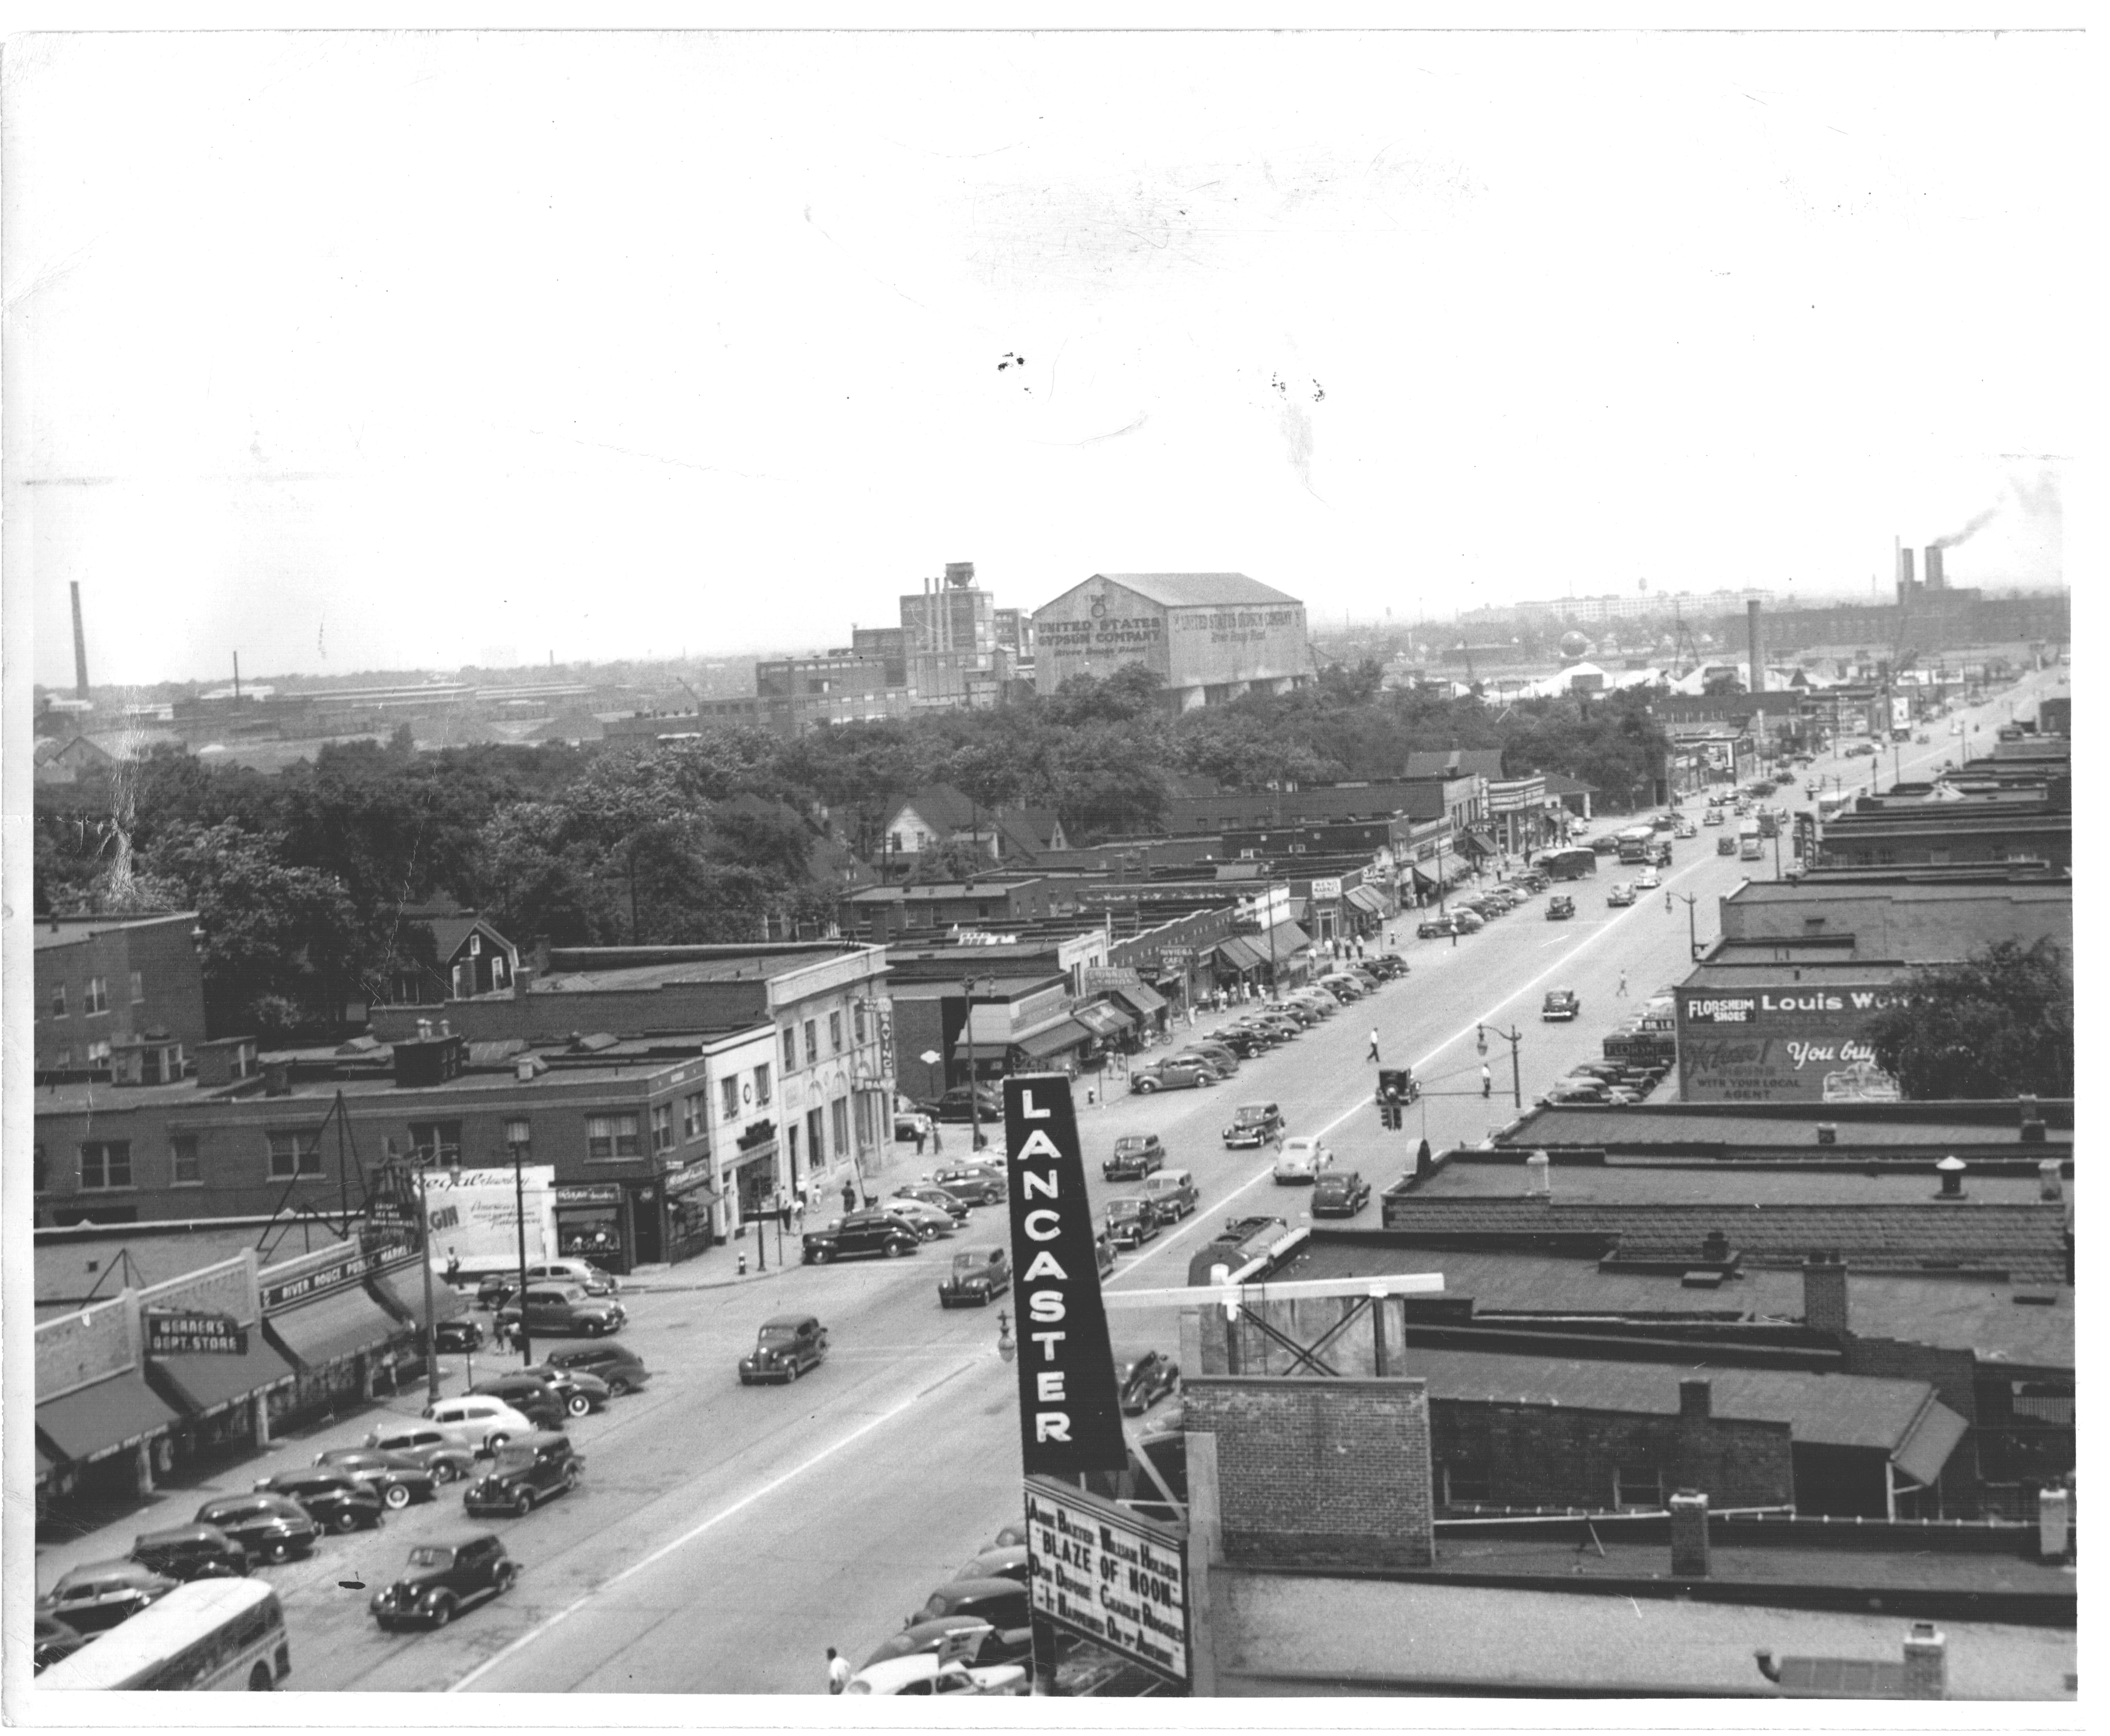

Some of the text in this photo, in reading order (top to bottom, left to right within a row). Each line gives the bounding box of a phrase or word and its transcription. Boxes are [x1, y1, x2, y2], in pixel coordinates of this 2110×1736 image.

[1038, 617, 1160, 633] UNITED STATES
[1039, 630, 1160, 646] GYPSUM COMPANY
[1688, 999, 1754, 1018] FLORSHEIM
[1762, 993, 1843, 1010] Louis
[1714, 1012, 1746, 1022] SHOES
[1787, 1041, 1835, 1070] You
[1697, 1078, 1801, 1087] WITH YOUR LOCAL
[1723, 1090, 1771, 1099] AGENT
[1017, 1089, 1072, 1443] LANCASTER
[282, 1279, 309, 1299] RIVER
[193, 1335, 237, 1351] STORE
[1100, 1556, 1118, 1583] OF
